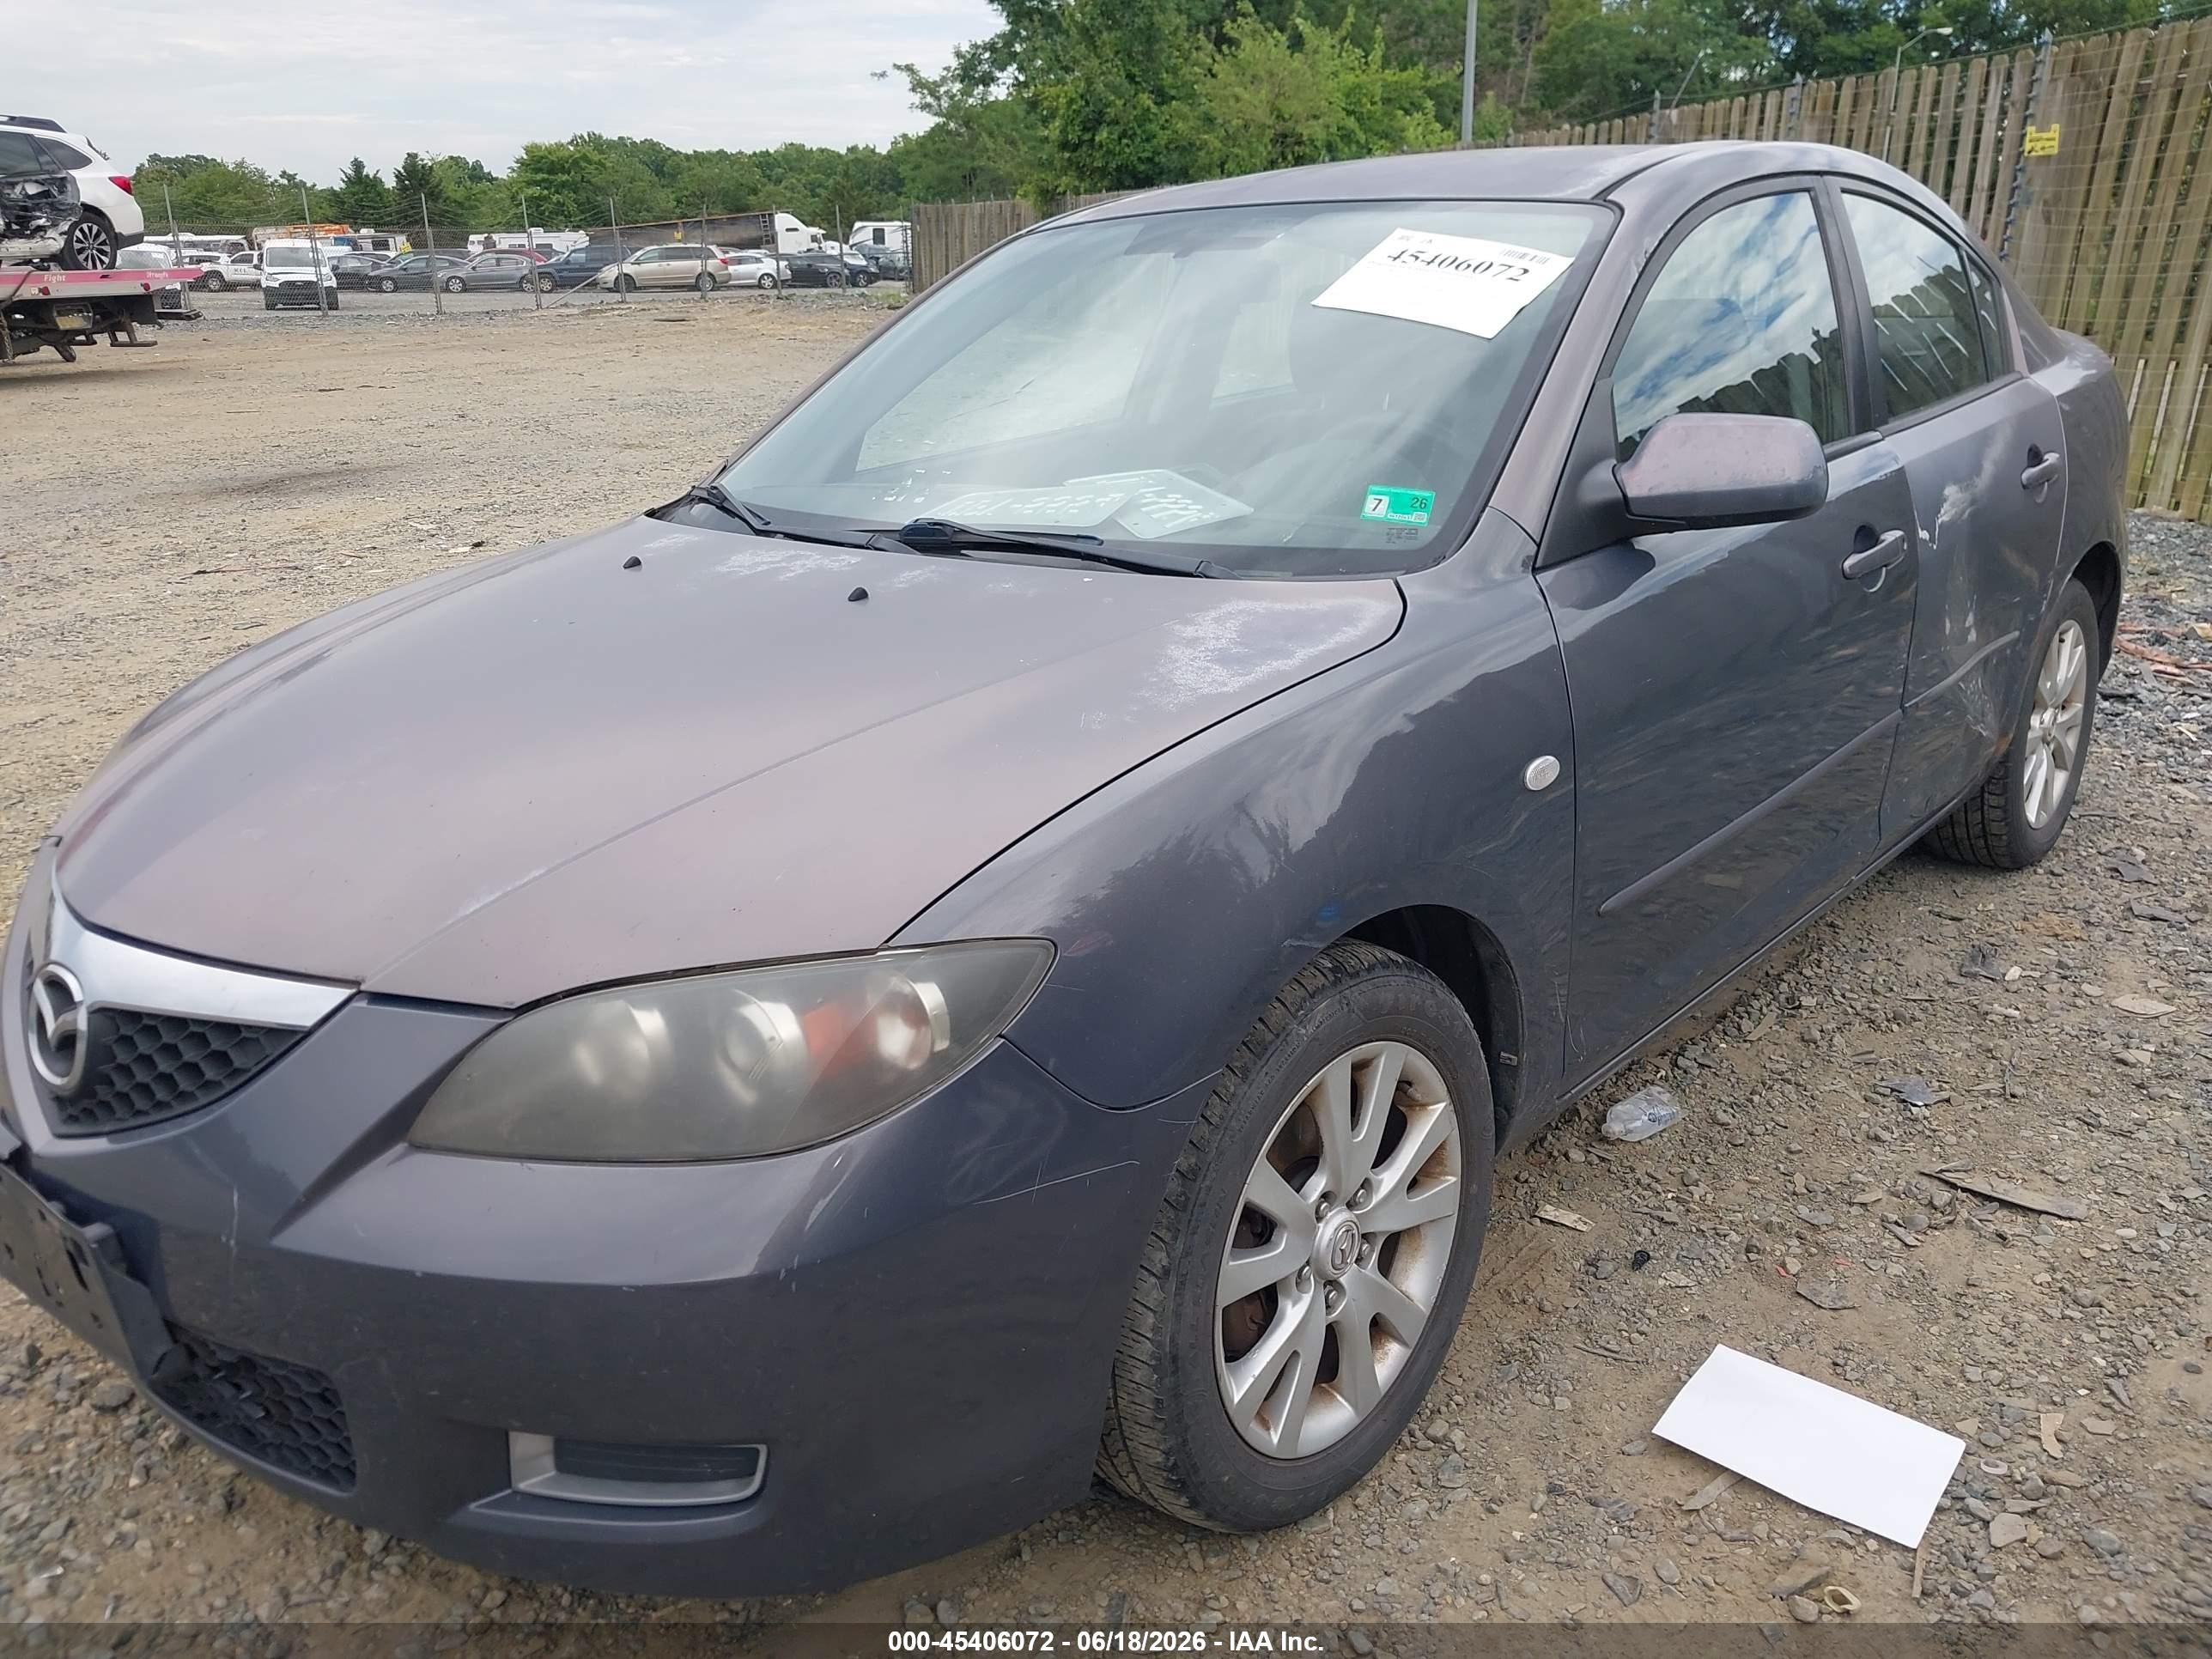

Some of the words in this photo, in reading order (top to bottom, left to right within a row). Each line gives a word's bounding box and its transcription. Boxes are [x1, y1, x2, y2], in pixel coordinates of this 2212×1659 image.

[1387, 248, 1529, 282] 45406072
[44, 274, 66, 283] Fight
[1371, 498, 1383, 512] 7
[1409, 496, 1428, 509] 26
